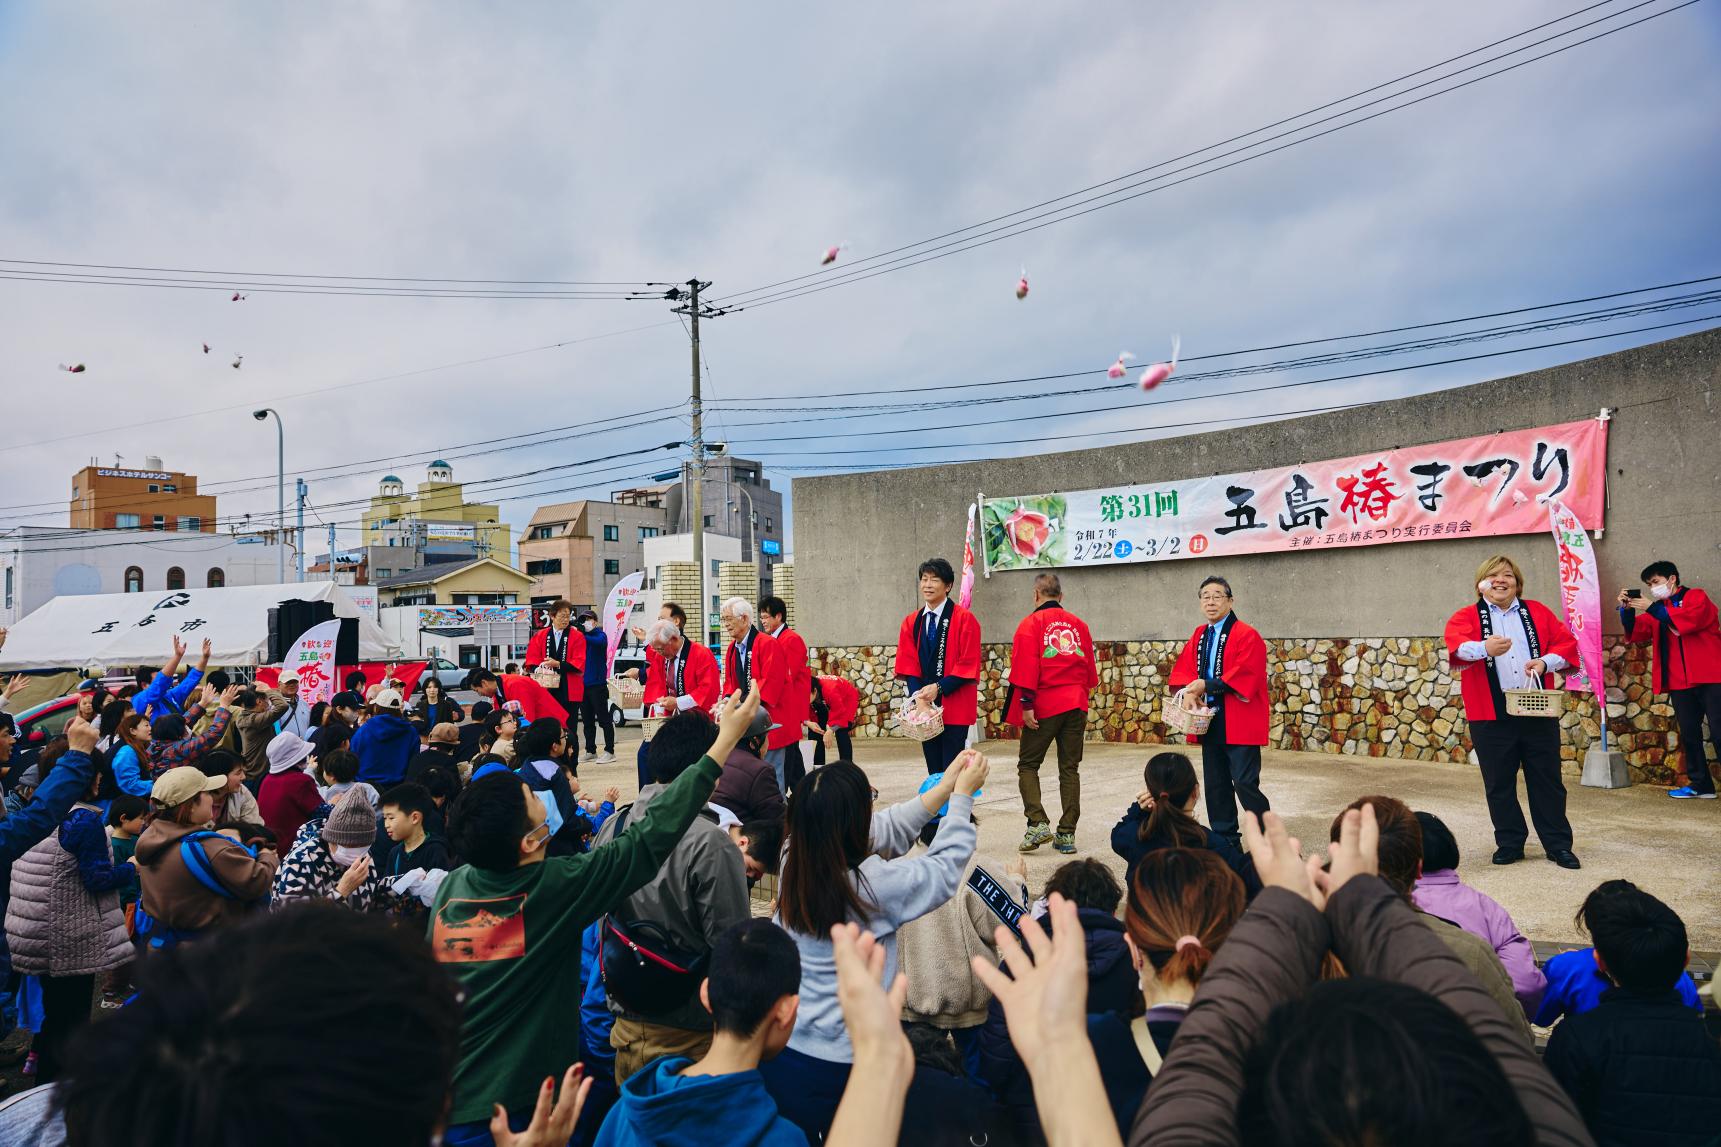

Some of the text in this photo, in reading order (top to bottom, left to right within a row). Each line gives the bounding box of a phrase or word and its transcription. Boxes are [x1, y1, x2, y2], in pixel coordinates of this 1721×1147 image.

[97, 469, 171, 480] ビジネスホテルサンコー
[1214, 442, 1569, 535] 五島椿まつり
[1100, 490, 1178, 523] 第31回
[1075, 528, 1117, 541] 令和7年
[976, 875, 1022, 929] THE THR
